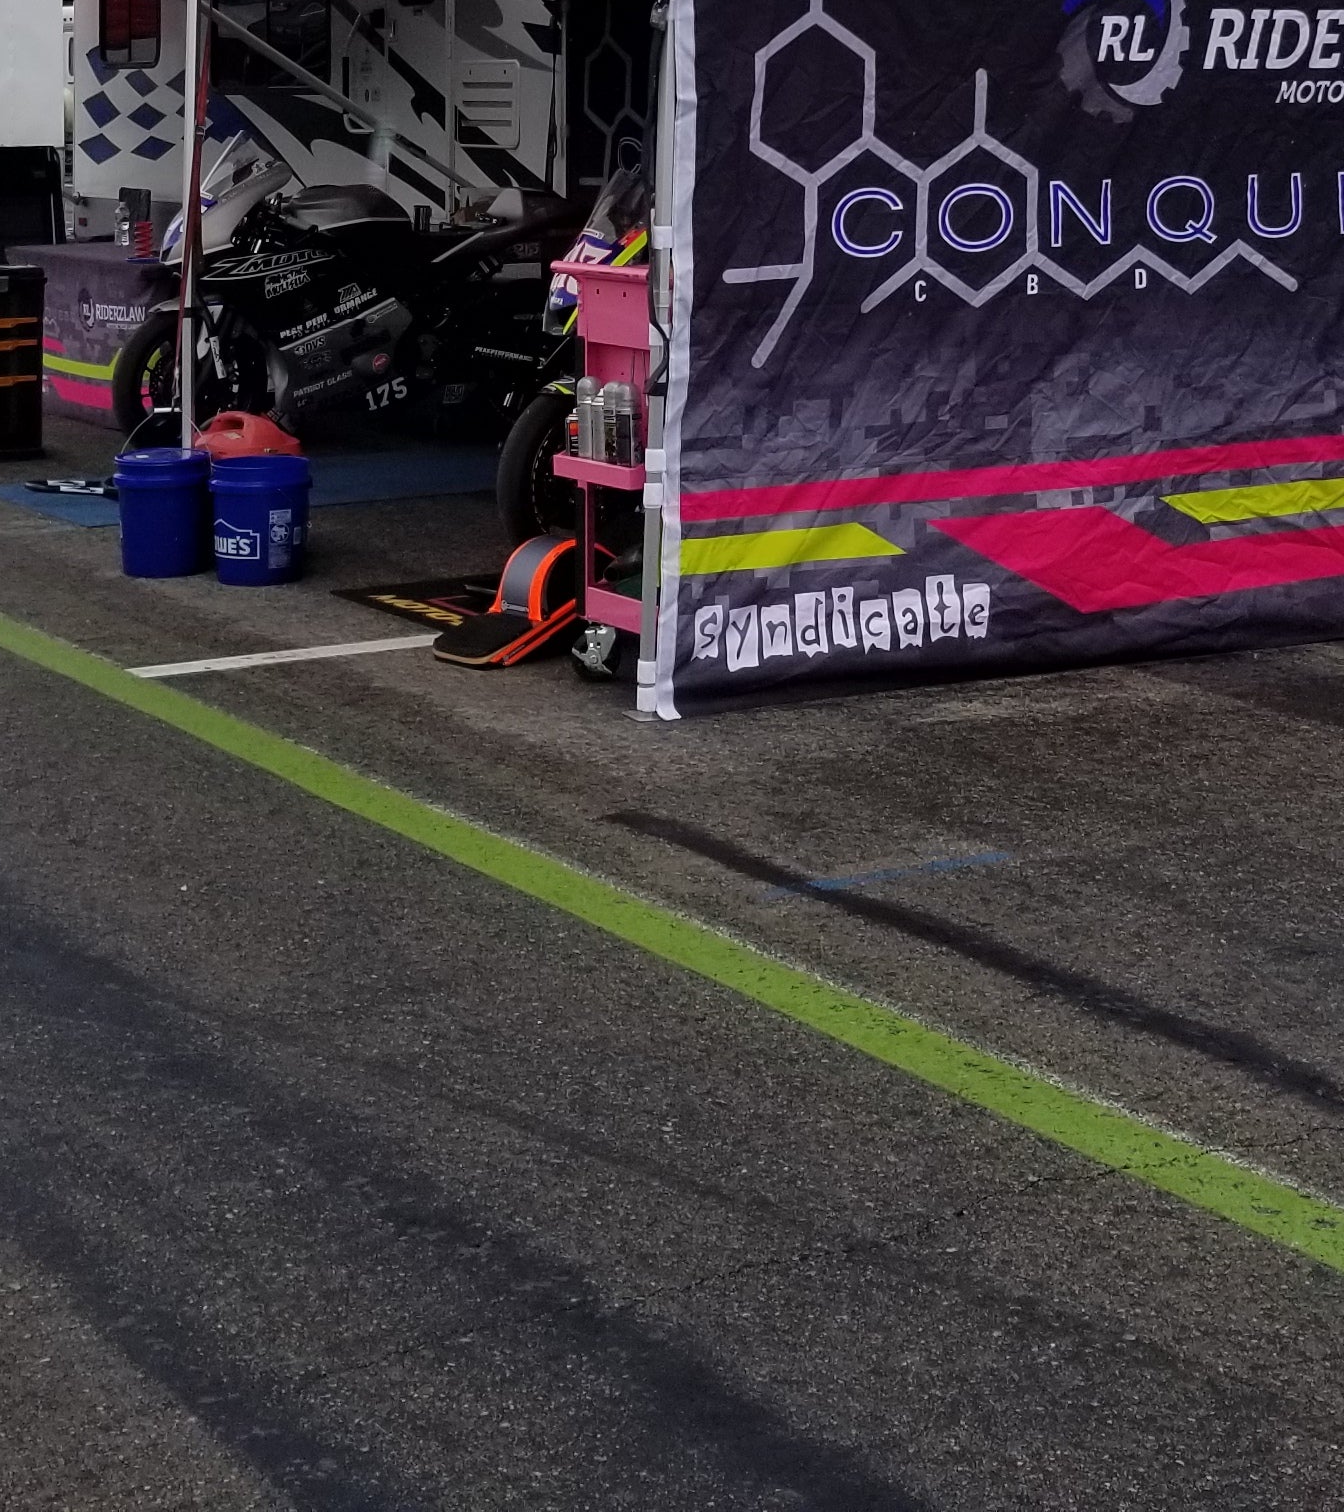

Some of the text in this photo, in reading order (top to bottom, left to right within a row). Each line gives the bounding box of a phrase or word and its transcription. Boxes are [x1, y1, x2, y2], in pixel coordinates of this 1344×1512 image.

[1098, 14, 1156, 64] RL
[96, 303, 146, 322] RIDERZLAW
[365, 376, 408, 412] 175
[693, 574, 991, 672] syndicate
